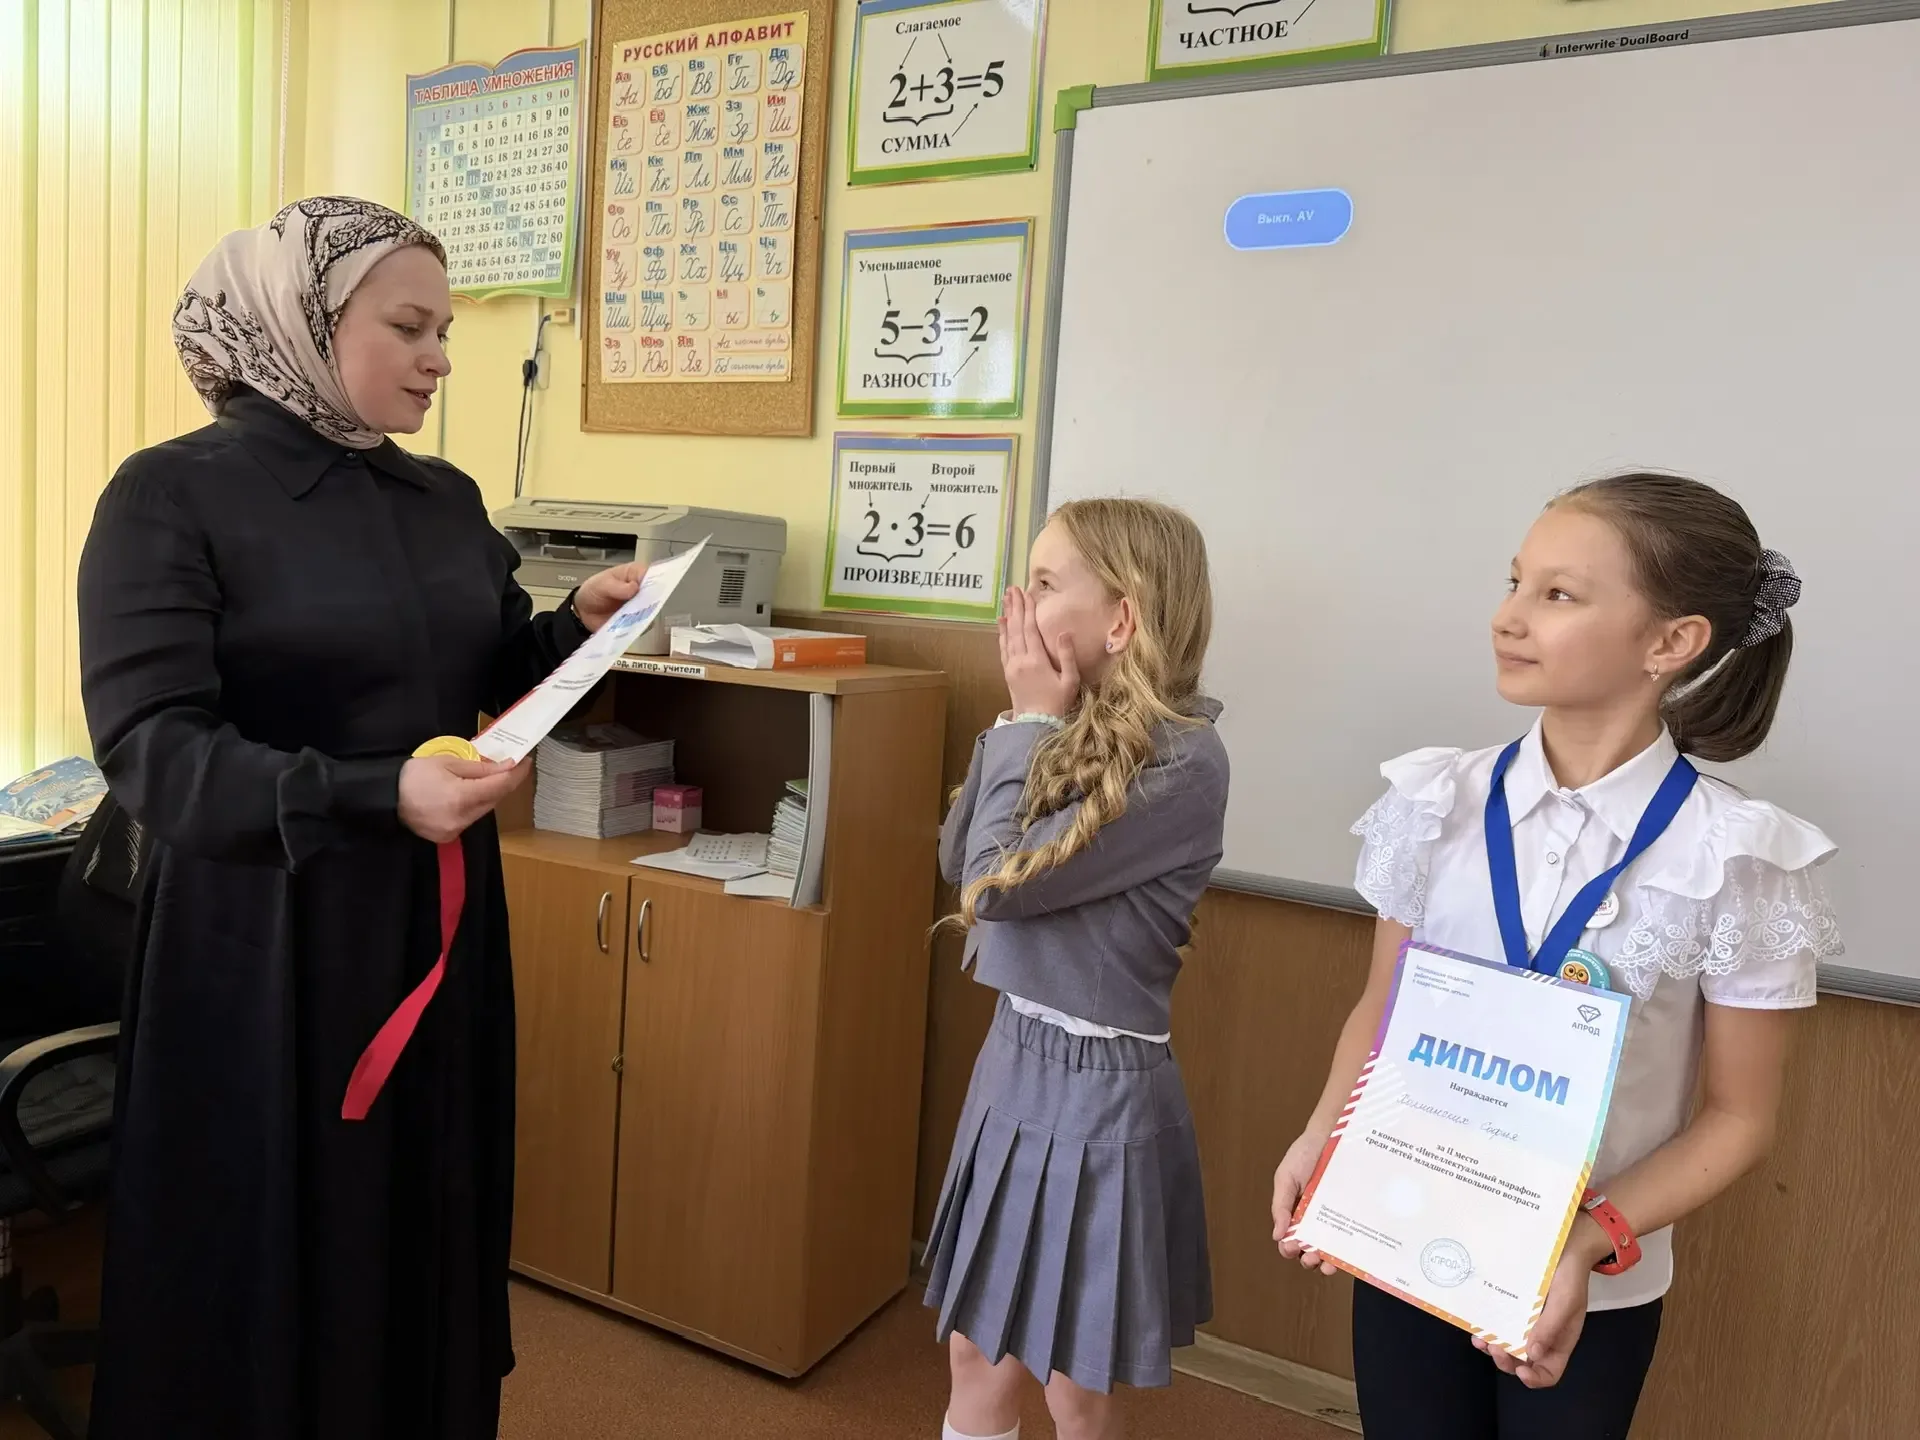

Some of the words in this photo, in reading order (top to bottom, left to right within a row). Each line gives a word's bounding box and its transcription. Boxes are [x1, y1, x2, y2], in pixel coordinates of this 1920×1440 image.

[896, 16, 961, 34] Слагаемое
[1179, 20, 1289, 49] ЧАСТНОЕ
[624, 33, 698, 62] РУССКИЙ
[706, 22, 794, 48] АЛФАВИТ
[1554, 38, 1616, 54] Interwrite
[1620, 30, 1690, 49] DualBoard
[415, 80, 479, 104] ТАБЛИЦА
[482, 61, 573, 91] УМНОЖЕНИЯ
[888, 60, 1005, 109] 2+3=5
[881, 133, 951, 154] СУММА
[1257, 212, 1293, 224] Выкл.
[1296, 209, 1314, 222] AV
[859, 258, 942, 273] Уменьшаемое
[934, 272, 1012, 286] Вычитаемое
[862, 372, 952, 388] РАЗНОСТЬ
[849, 461, 896, 476] Первый
[932, 464, 975, 478] Второй
[848, 480, 913, 492] множитель
[930, 484, 998, 494] множитель
[843, 567, 983, 588] ПРОИЗВЕДЕНИЕ
[632, 662, 661, 671] литер.
[663, 665, 701, 674] учителя
[1572, 1022, 1600, 1037] АПРОД
[1408, 1033, 1570, 1106] ДИПЛОМ
[1449, 1082, 1508, 1108] Награждается
[1436, 1143, 1445, 1151] за
[1455, 1151, 1479, 1165] место
[1365, 1136, 1389, 1150] среди
[1389, 1145, 1413, 1161] детей
[1414, 1157, 1454, 1177] младшего
[1455, 1174, 1501, 1196] школьного
[1502, 1192, 1541, 1211] возраста
[1378, 1131, 1414, 1150] конкурсе
[1415, 1146, 1497, 1183] «Интеллектуальный
[1498, 1178, 1541, 1200] марафон»
